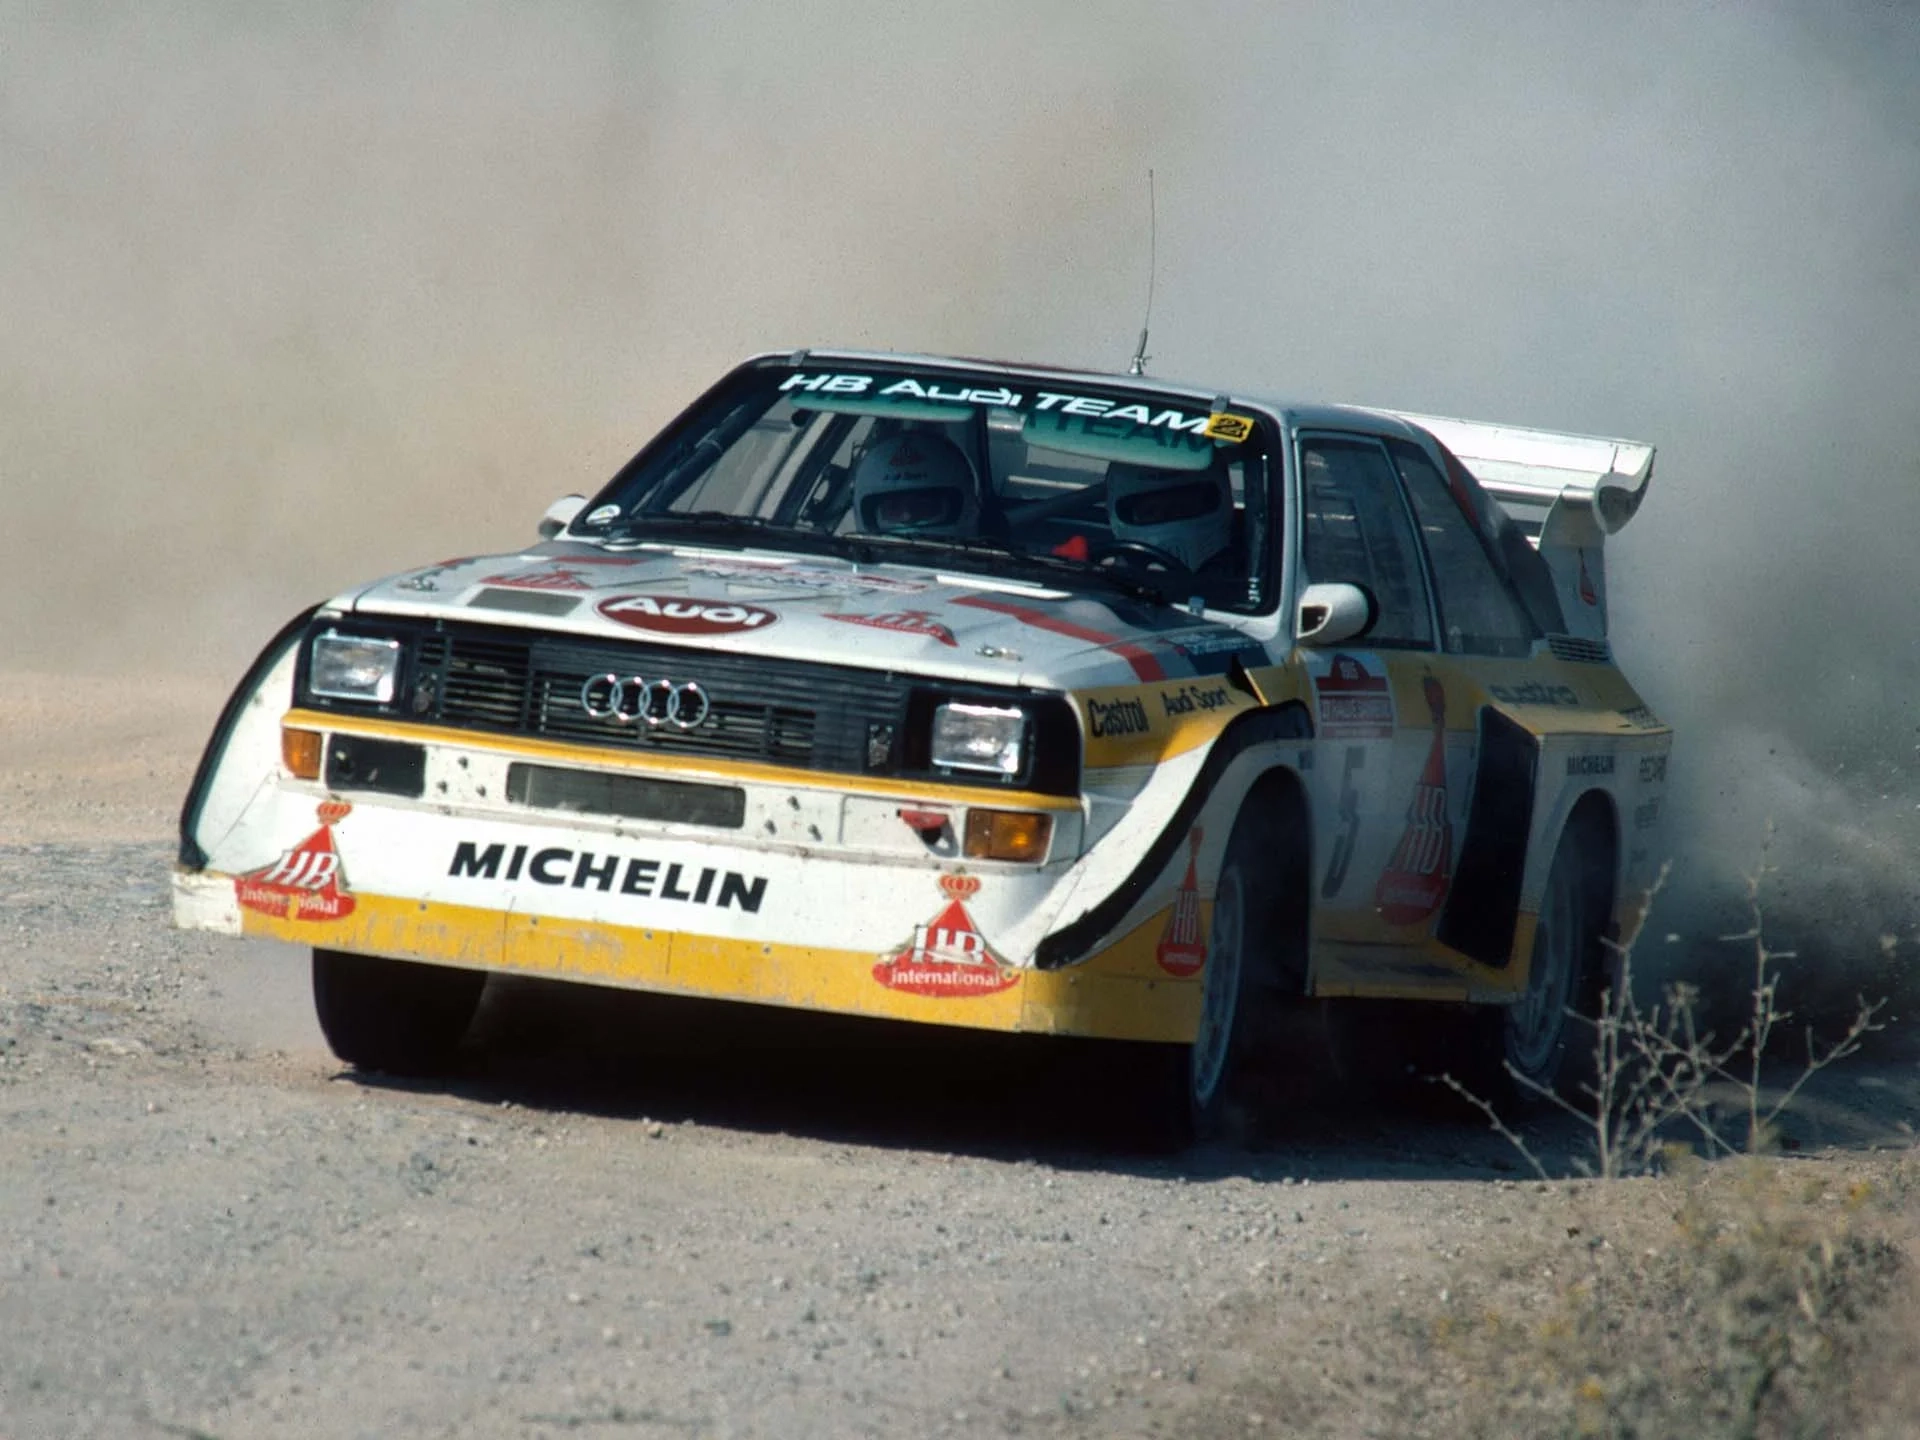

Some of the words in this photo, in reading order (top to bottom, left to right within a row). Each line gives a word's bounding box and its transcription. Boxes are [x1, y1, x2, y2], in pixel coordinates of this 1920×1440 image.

[778, 373, 873, 393] HB
[879, 379, 1022, 407] Audi
[1035, 392, 1208, 435] TEAM
[1088, 698, 1149, 738] Castrol
[1160, 688, 1196, 717] Audi
[1189, 685, 1235, 712] Sport
[1321, 745, 1366, 899] 5
[264, 851, 339, 890] HB
[448, 841, 769, 914] MICHELIN
[912, 927, 985, 964] HB
